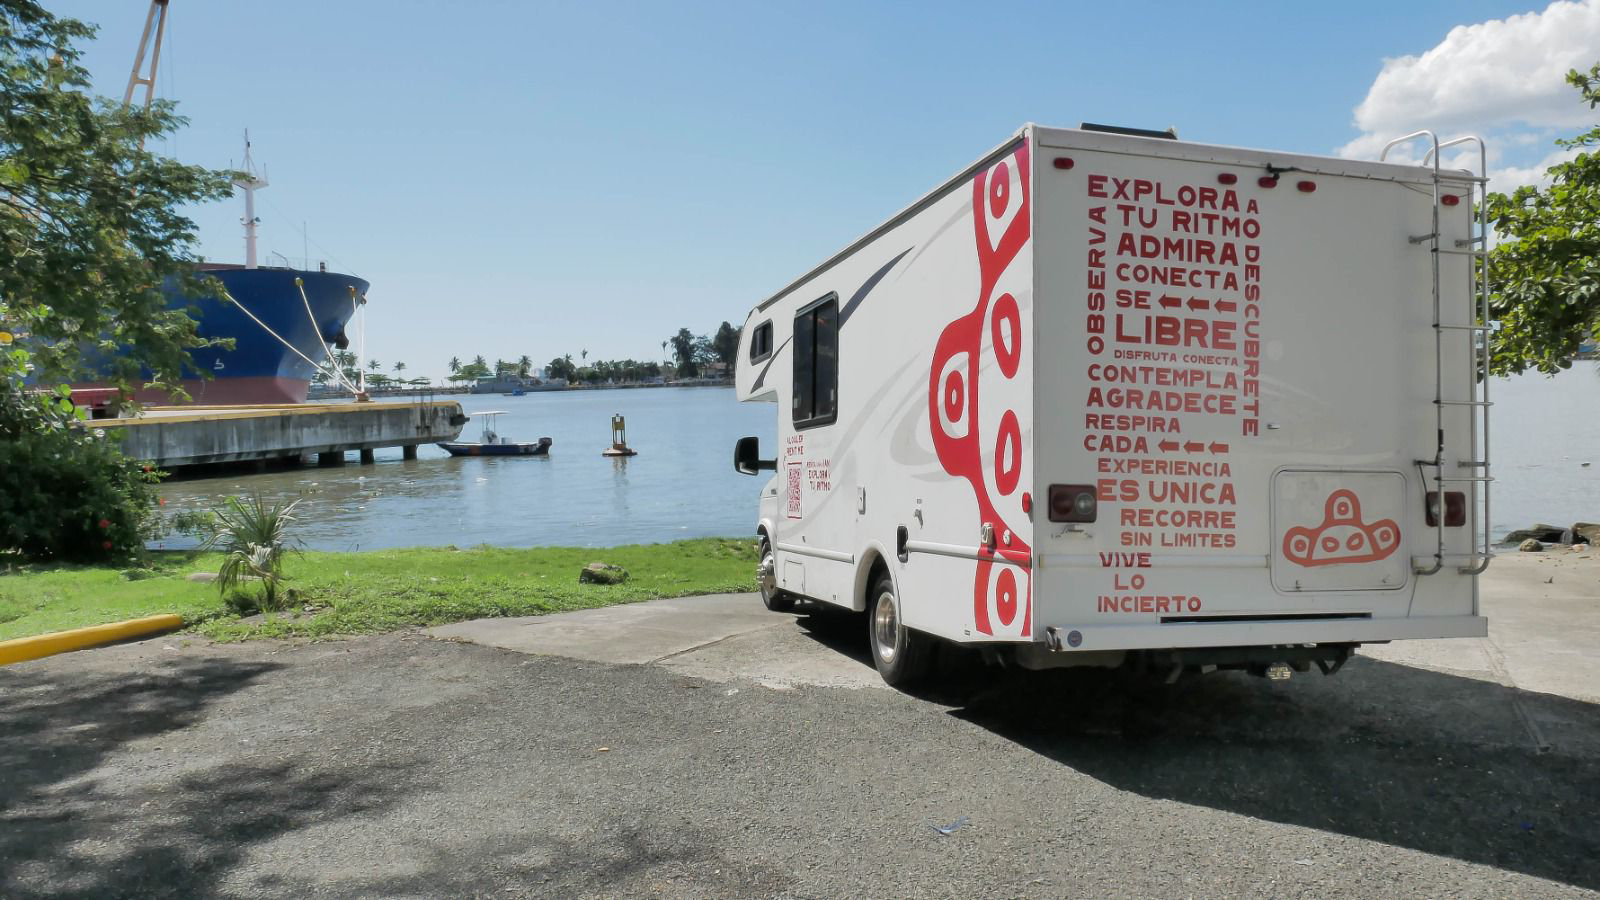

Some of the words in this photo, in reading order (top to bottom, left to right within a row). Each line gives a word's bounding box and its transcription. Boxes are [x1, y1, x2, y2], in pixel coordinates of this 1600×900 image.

[1088, 174, 1240, 212] EXPLORA
[1247, 199, 1259, 214] A
[1117, 204, 1158, 229] TU
[1172, 210, 1260, 239] RITMO
[1116, 232, 1239, 266] ADMIRA
[1087, 206, 1106, 355] OBSERVA
[1116, 263, 1239, 291] CONECTA
[1115, 289, 1151, 309] SE
[1115, 314, 1237, 351] LIBRE
[1242, 245, 1260, 436] DESCUBRETE
[1114, 349, 1178, 362] DISFRUTA
[1183, 354, 1239, 366] CONECTA
[1087, 363, 1238, 389] CONTEMPLA
[1087, 387, 1237, 415] AGRADECE
[1085, 413, 1181, 433] RESPIRA
[1084, 435, 1149, 454] CADA
[1097, 457, 1231, 477] EXPERIENCIA
[1097, 479, 1140, 502] ES
[1148, 480, 1236, 505] UNICA
[1120, 508, 1236, 529] RECORRE
[1120, 532, 1152, 547] SIN
[1161, 532, 1236, 548] LIMITES
[1099, 552, 1152, 568] VIVE
[1114, 574, 1145, 590] LO
[1097, 595, 1201, 613] INCIERTO
